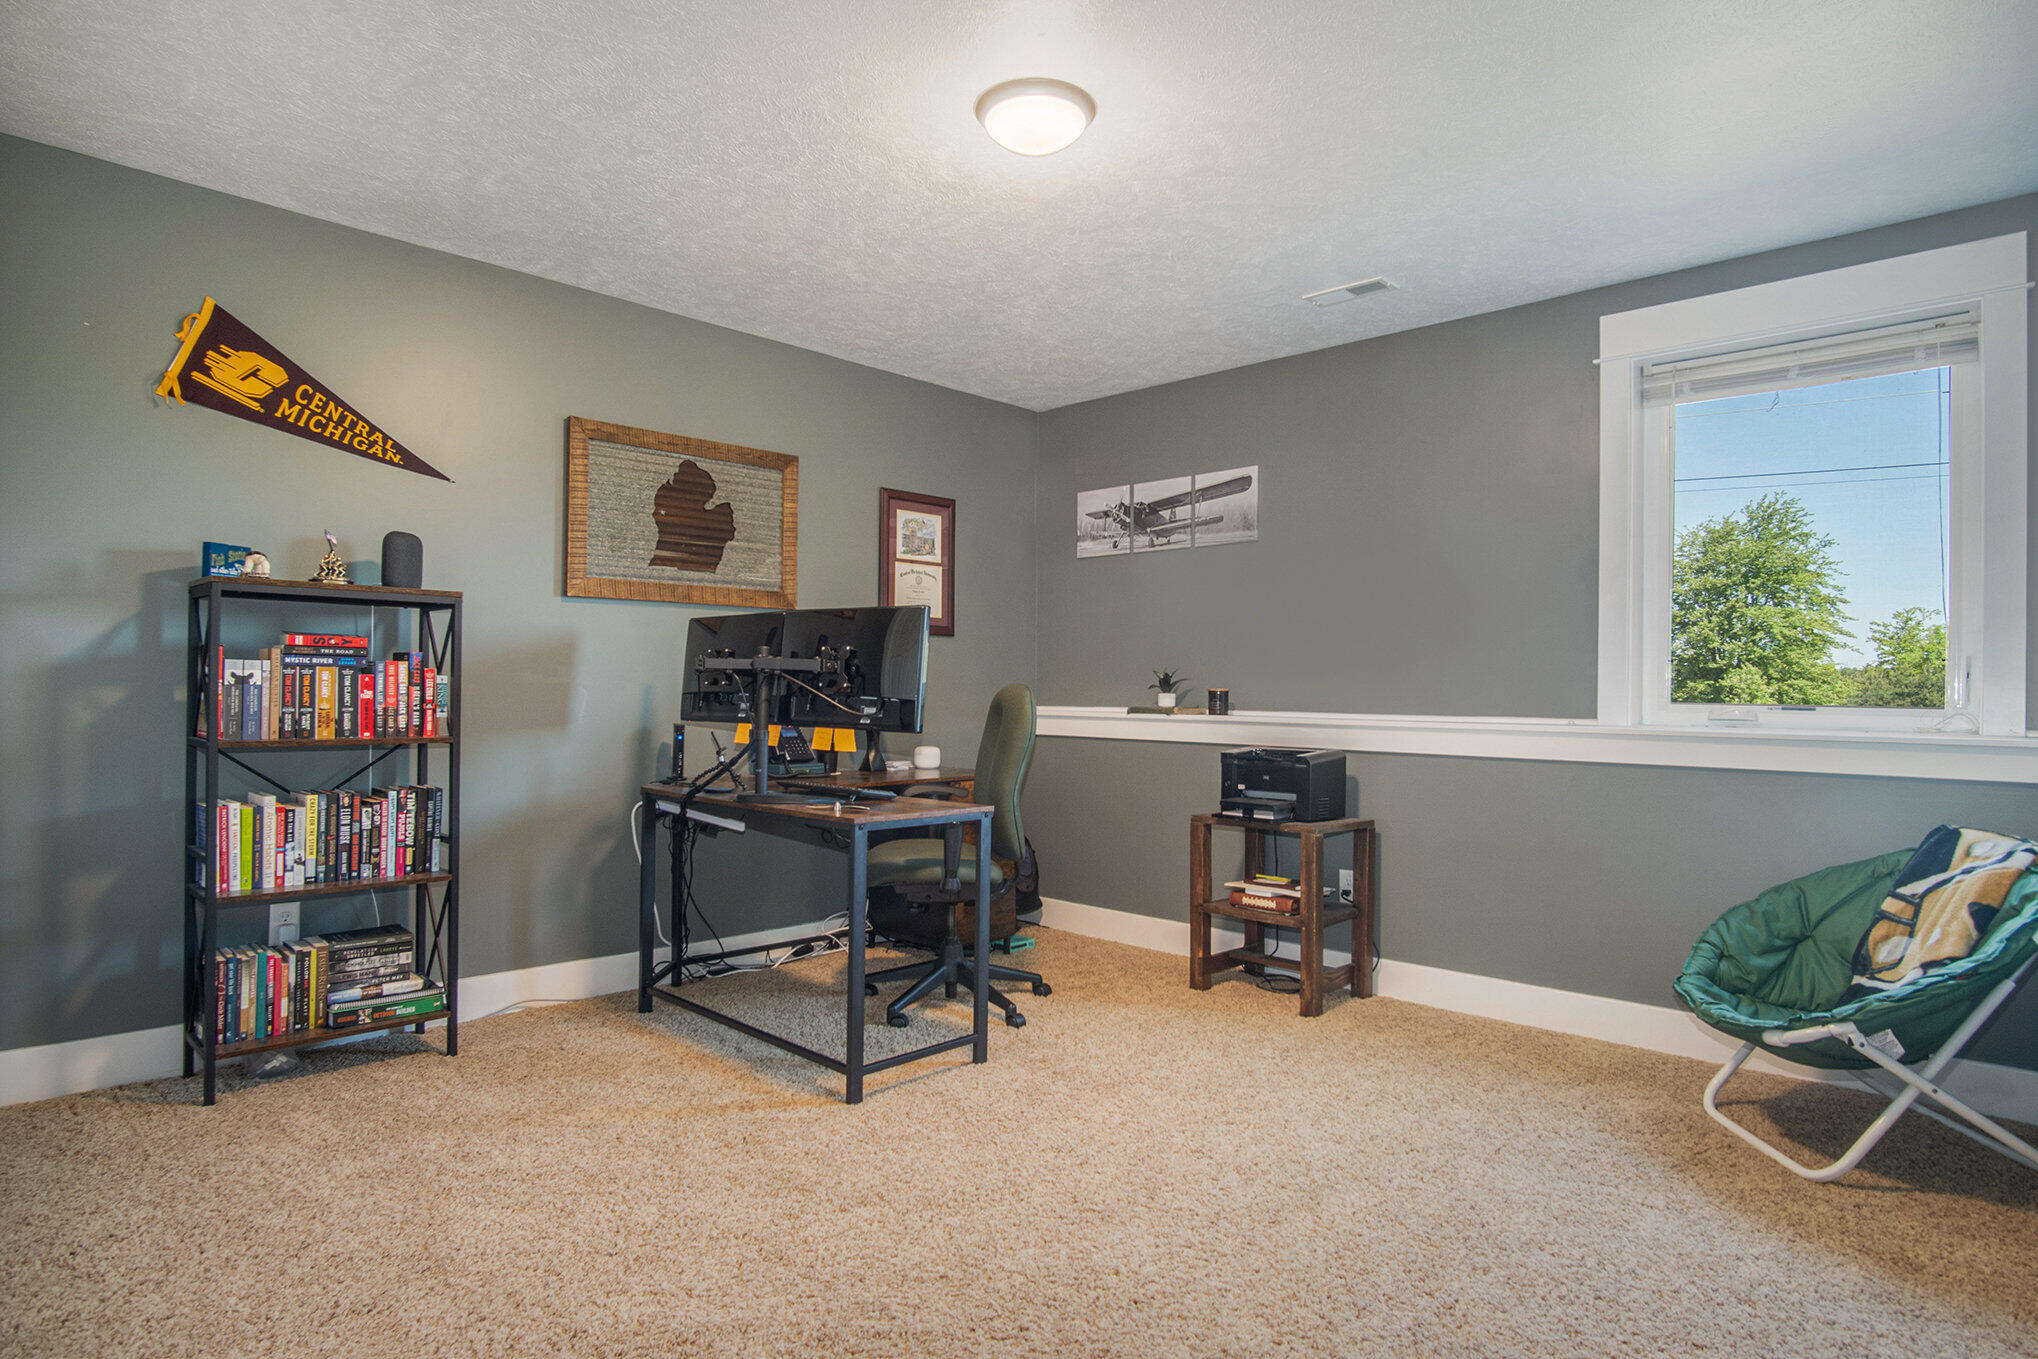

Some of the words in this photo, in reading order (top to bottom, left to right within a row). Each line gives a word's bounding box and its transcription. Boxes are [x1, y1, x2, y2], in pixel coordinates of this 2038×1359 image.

[274, 398, 400, 464] MICHIGAN
[295, 384, 397, 453] CENTRAL
[407, 792, 415, 810] TIM
[265, 811, 273, 842] Atomic
[341, 808, 350, 824] ELON
[340, 826, 350, 845] MUSK
[406, 812, 415, 846] TEBOW
[264, 844, 273, 869] Habits
[318, 951, 327, 972] JESUS
[318, 975, 327, 1000] RISEN
